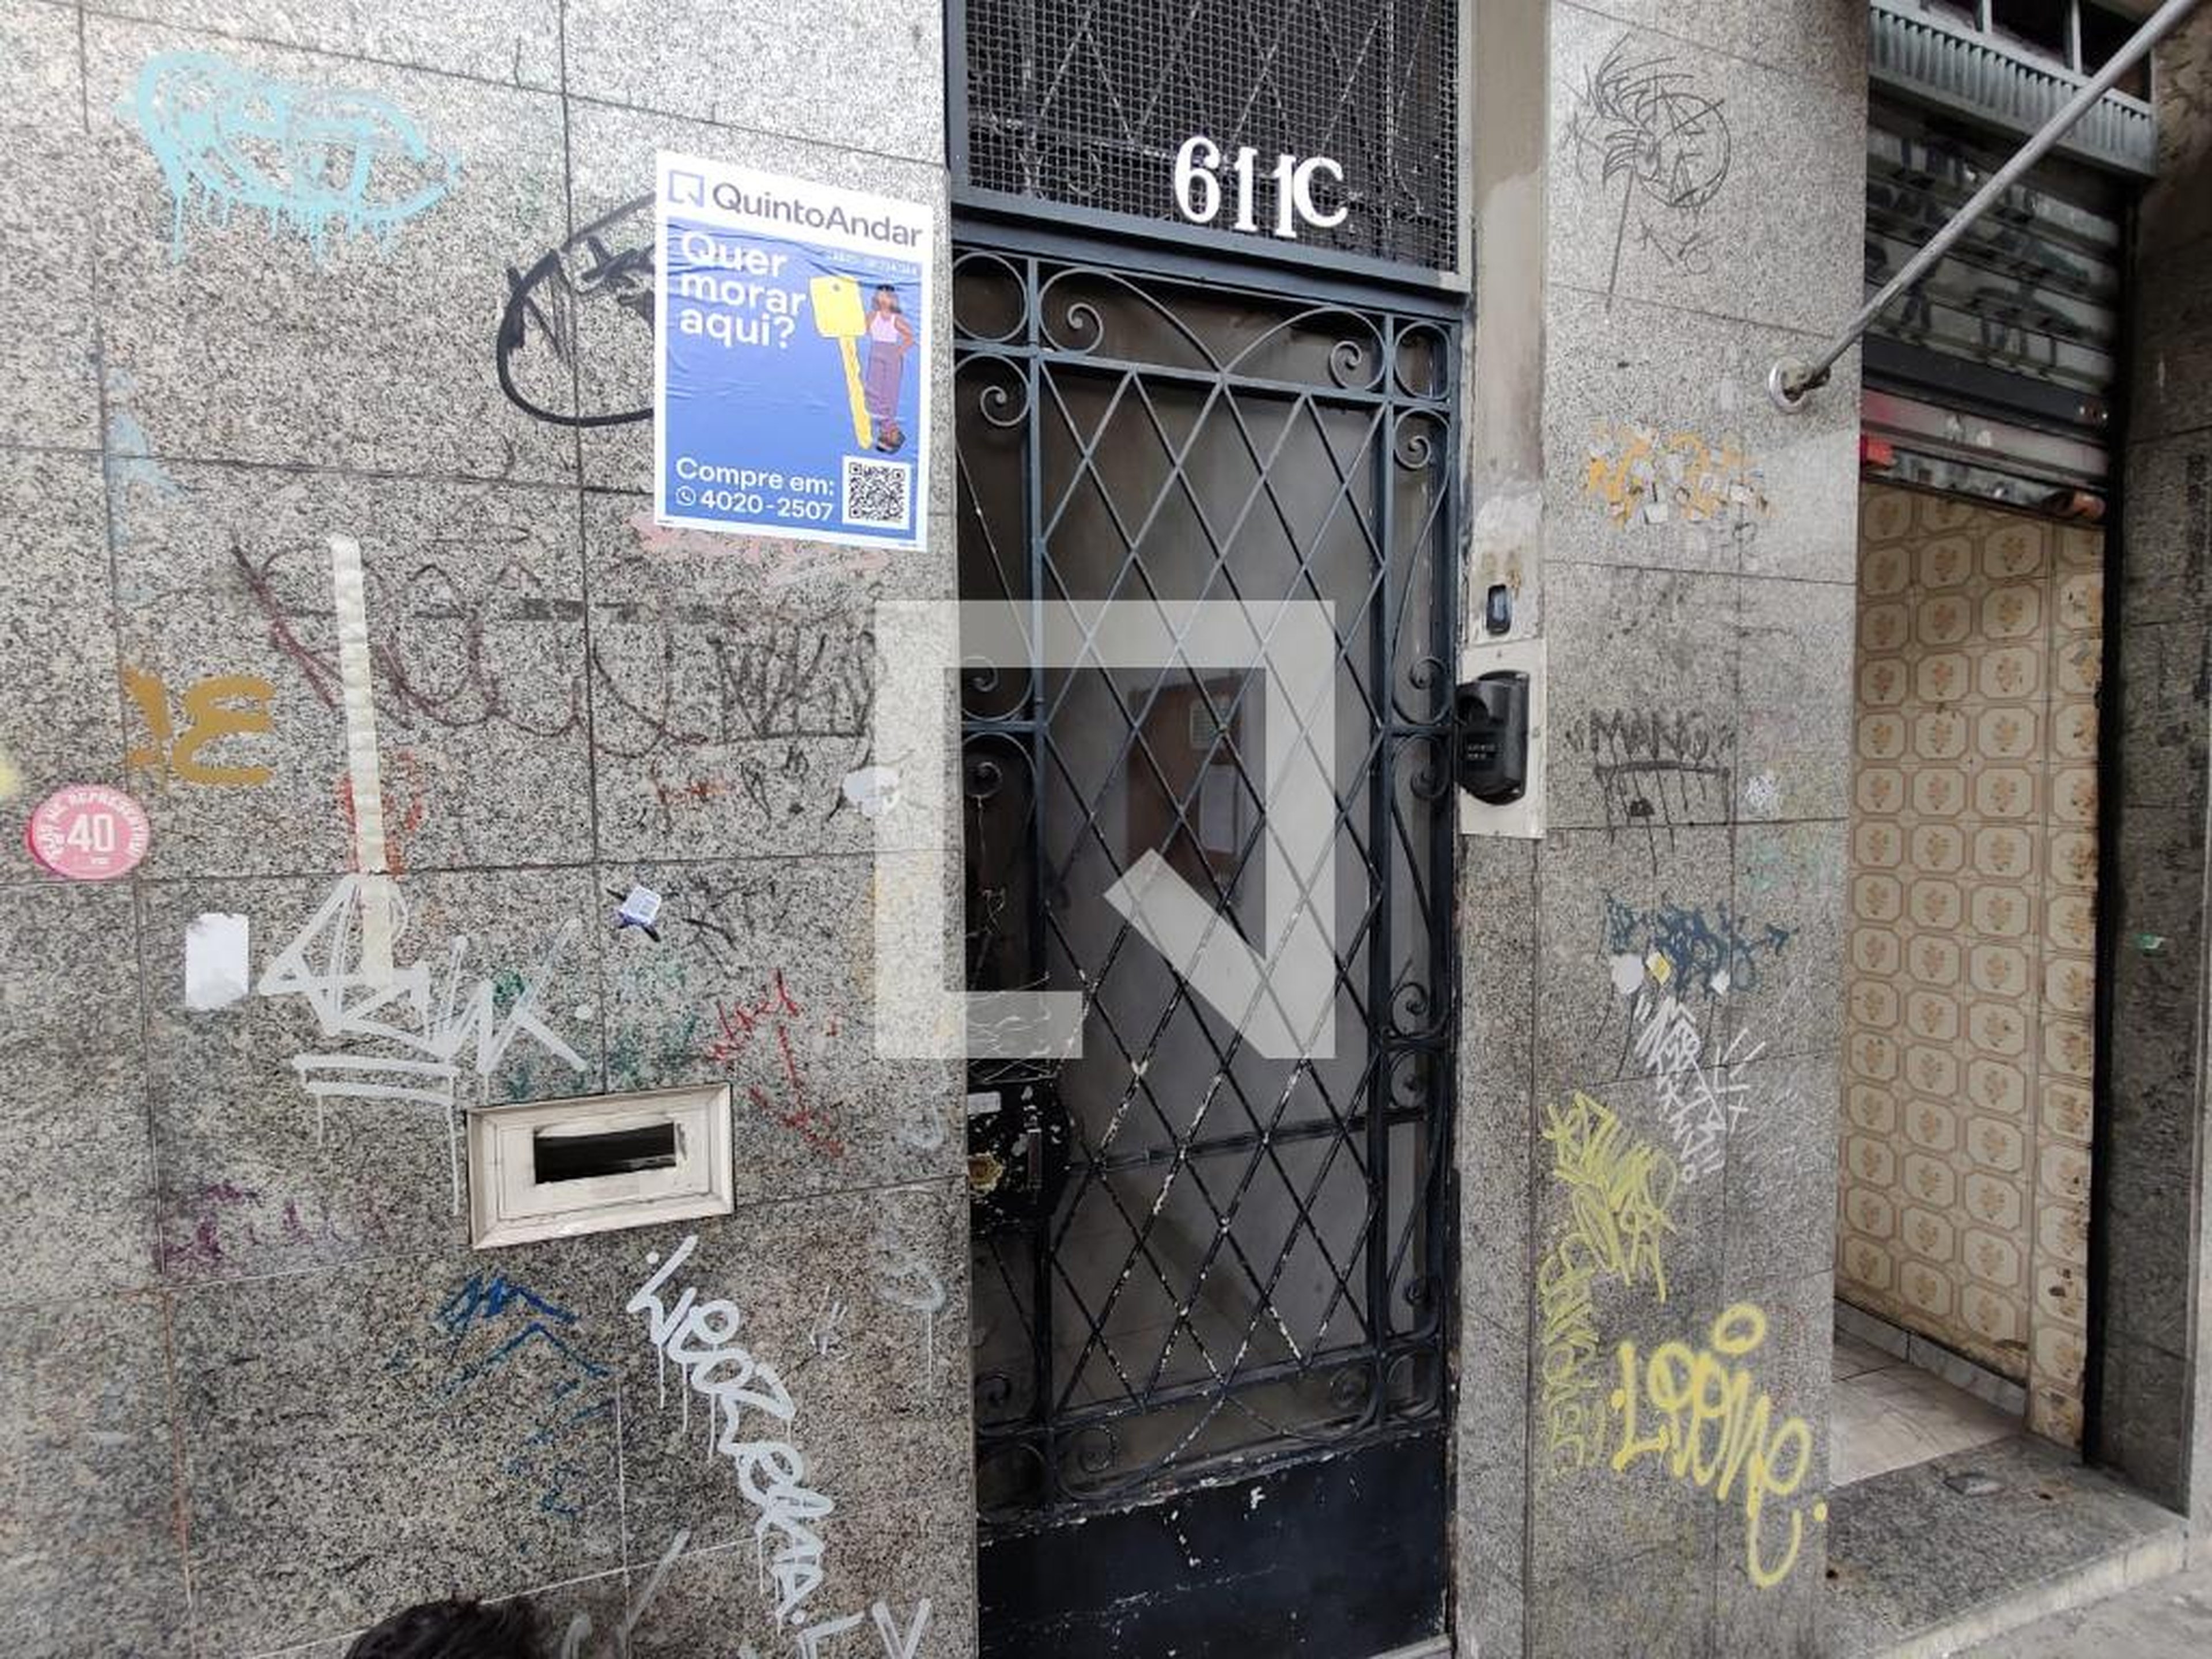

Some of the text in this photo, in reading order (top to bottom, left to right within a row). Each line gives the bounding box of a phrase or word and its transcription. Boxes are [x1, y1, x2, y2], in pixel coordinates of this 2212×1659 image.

[1175, 136, 1348, 238] 611C
[712, 181, 923, 248] QuintoAndar
[681, 231, 788, 278] Quer
[680, 274, 806, 316] morar
[680, 307, 796, 348] aqui?
[676, 457, 835, 497] Compre em:
[66, 813, 116, 853] 40
